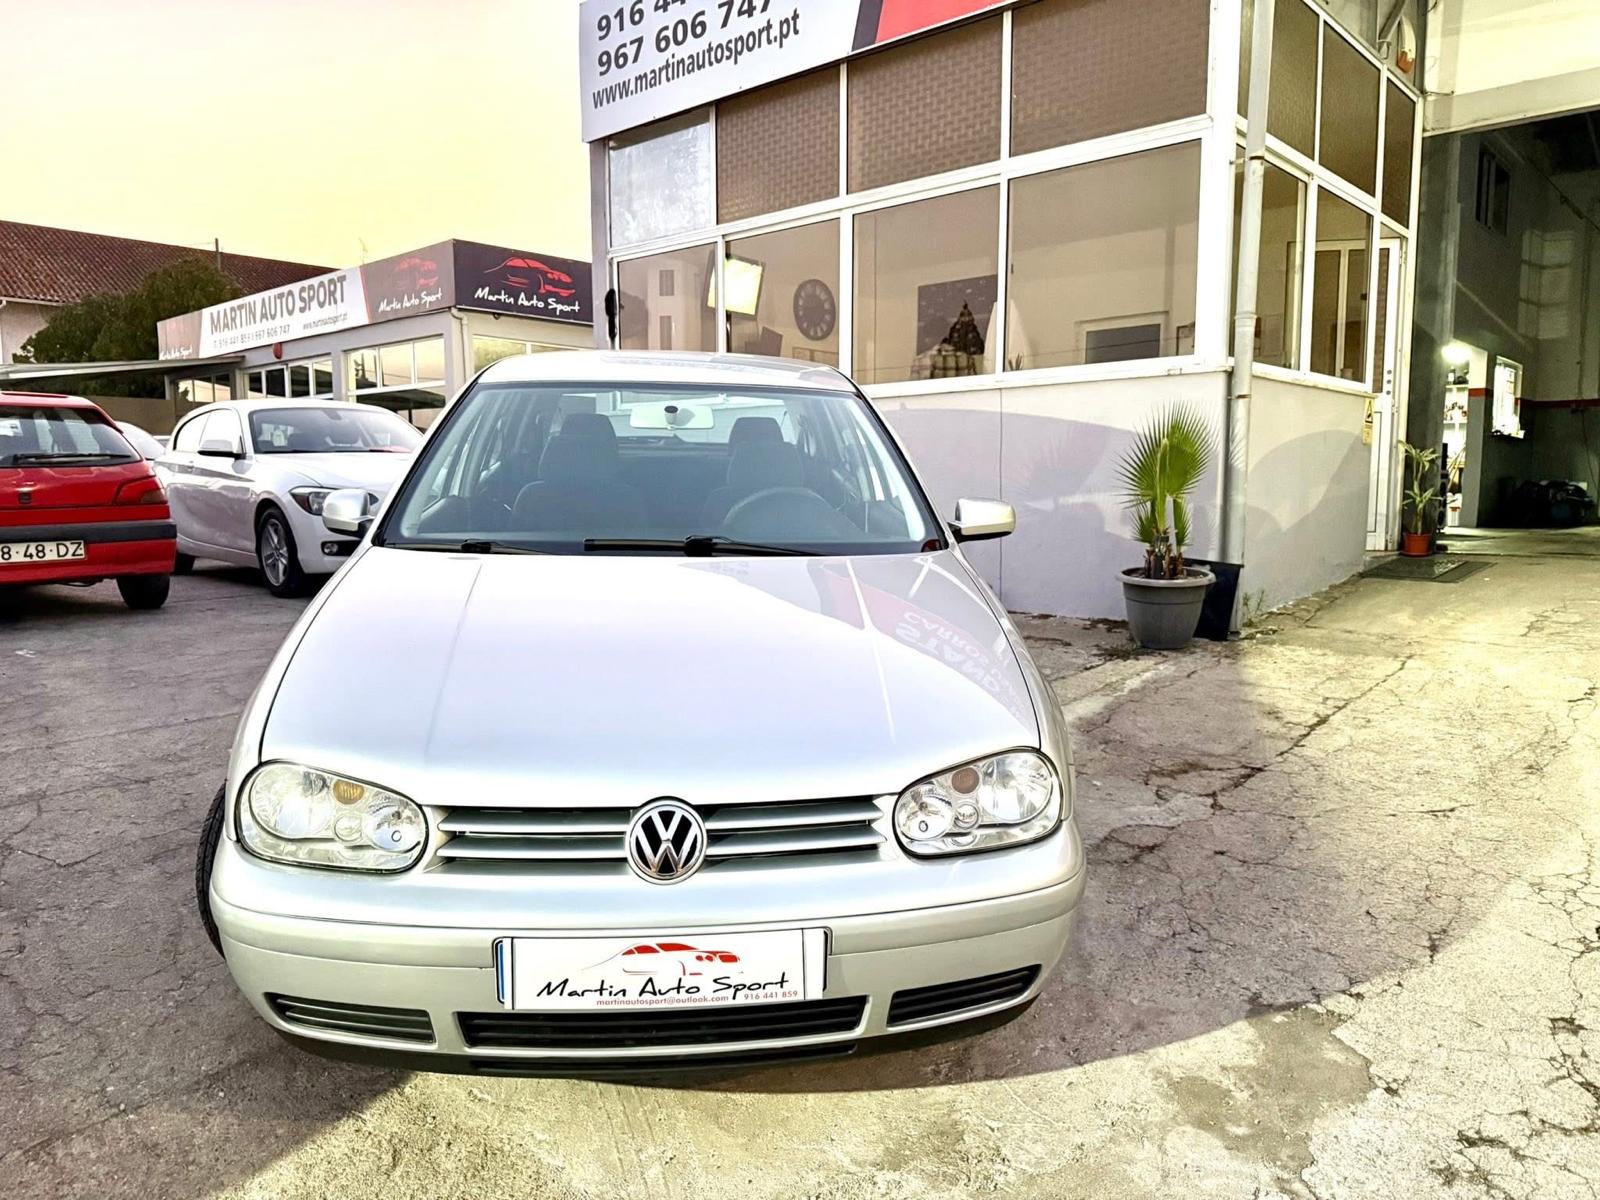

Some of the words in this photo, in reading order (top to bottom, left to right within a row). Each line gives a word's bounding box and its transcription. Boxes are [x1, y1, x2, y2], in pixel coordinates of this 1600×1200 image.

[597, 1, 645, 41] 916
[592, 8, 800, 109] www.martinautosport.pt
[598, 36, 645, 76] 967
[655, 10, 707, 53] 606
[210, 301, 257, 335] MARTIN
[259, 289, 296, 326] AUTO
[298, 275, 347, 314] SPORT
[378, 299, 401, 313] Martin
[402, 293, 420, 310] Auto
[421, 287, 443, 309] Sport
[474, 286, 515, 305] Martin
[517, 293, 546, 309] Auto
[547, 297, 581, 316] Sport
[536, 977, 628, 998] Martin
[637, 976, 701, 997] Auto
[712, 971, 790, 1001] Sport
[596, 995, 729, 1006] martinautosport@outlook.com
[743, 993, 760, 1001] 916
[762, 991, 779, 1000] 441
[781, 990, 799, 999] 859
